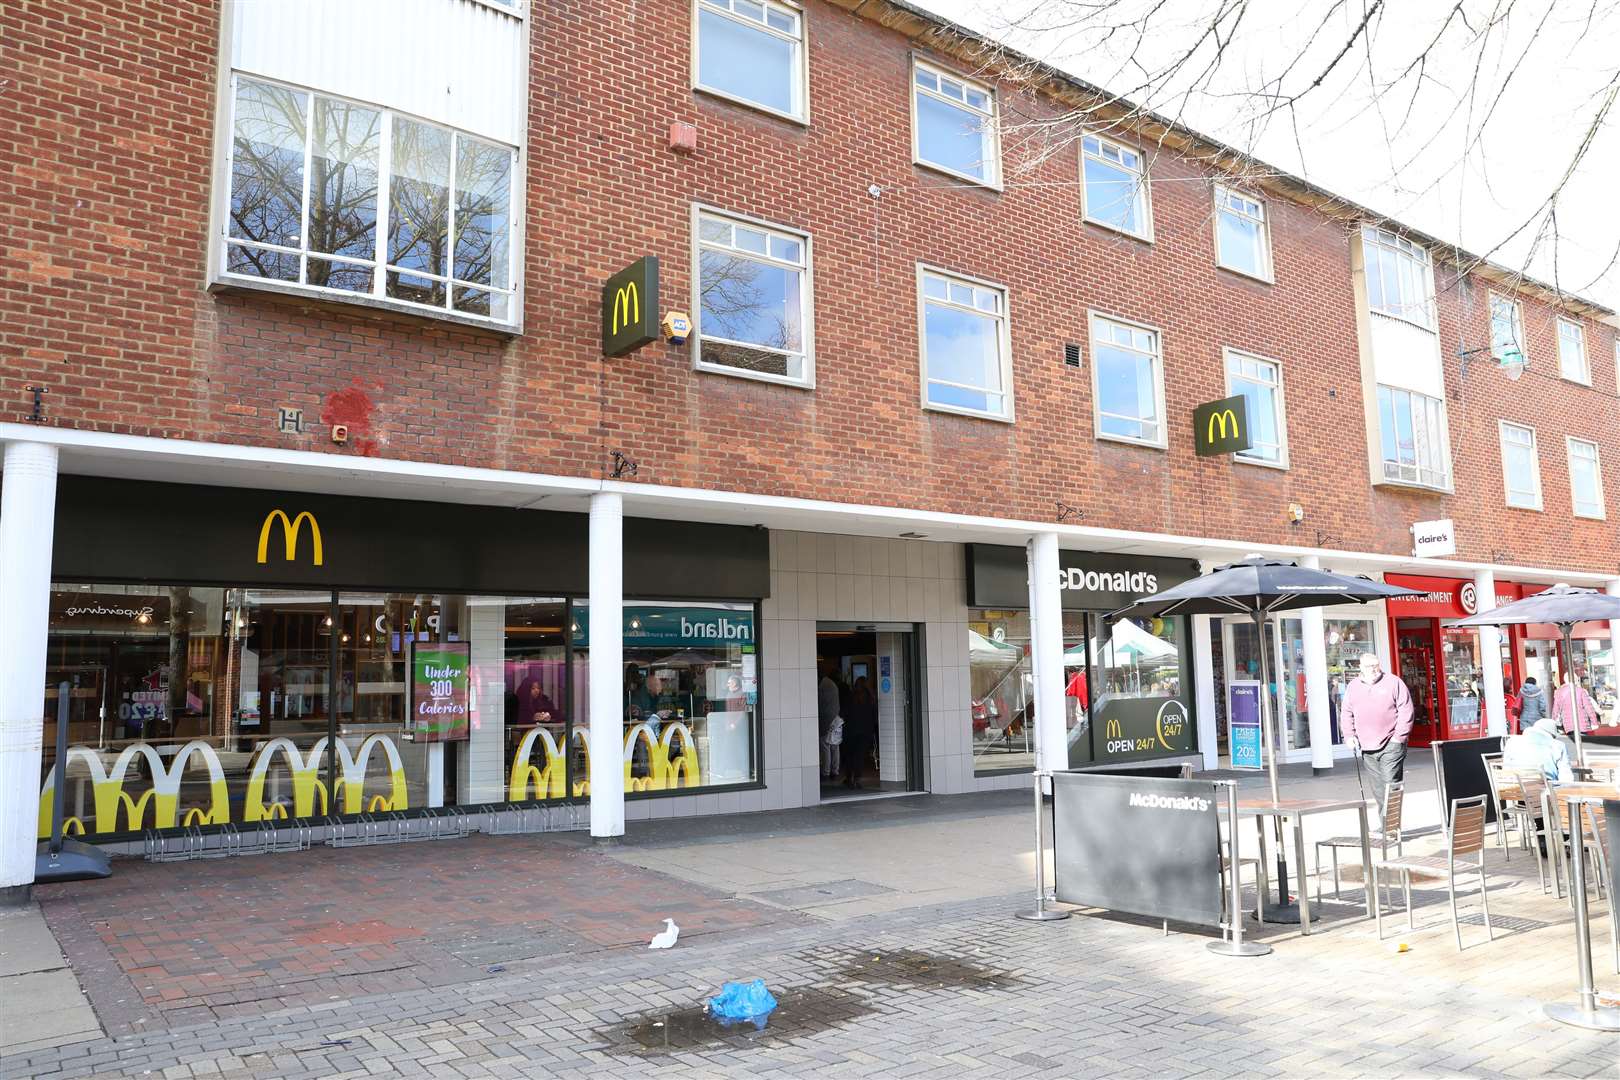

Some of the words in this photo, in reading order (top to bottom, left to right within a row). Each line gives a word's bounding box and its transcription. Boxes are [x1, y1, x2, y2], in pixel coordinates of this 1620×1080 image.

[1418, 533, 1448, 544] claire's
[1060, 567, 1158, 594] cDonald's
[425, 665, 461, 679] Under
[430, 680, 453, 697] 300
[420, 701, 465, 715] Calories
[1163, 714, 1182, 725] OPEN
[1164, 725, 1182, 737] 24/7
[1107, 740, 1134, 753] OPEN
[1136, 738, 1155, 750] 24/7
[1129, 793, 1208, 812] McDonald's
